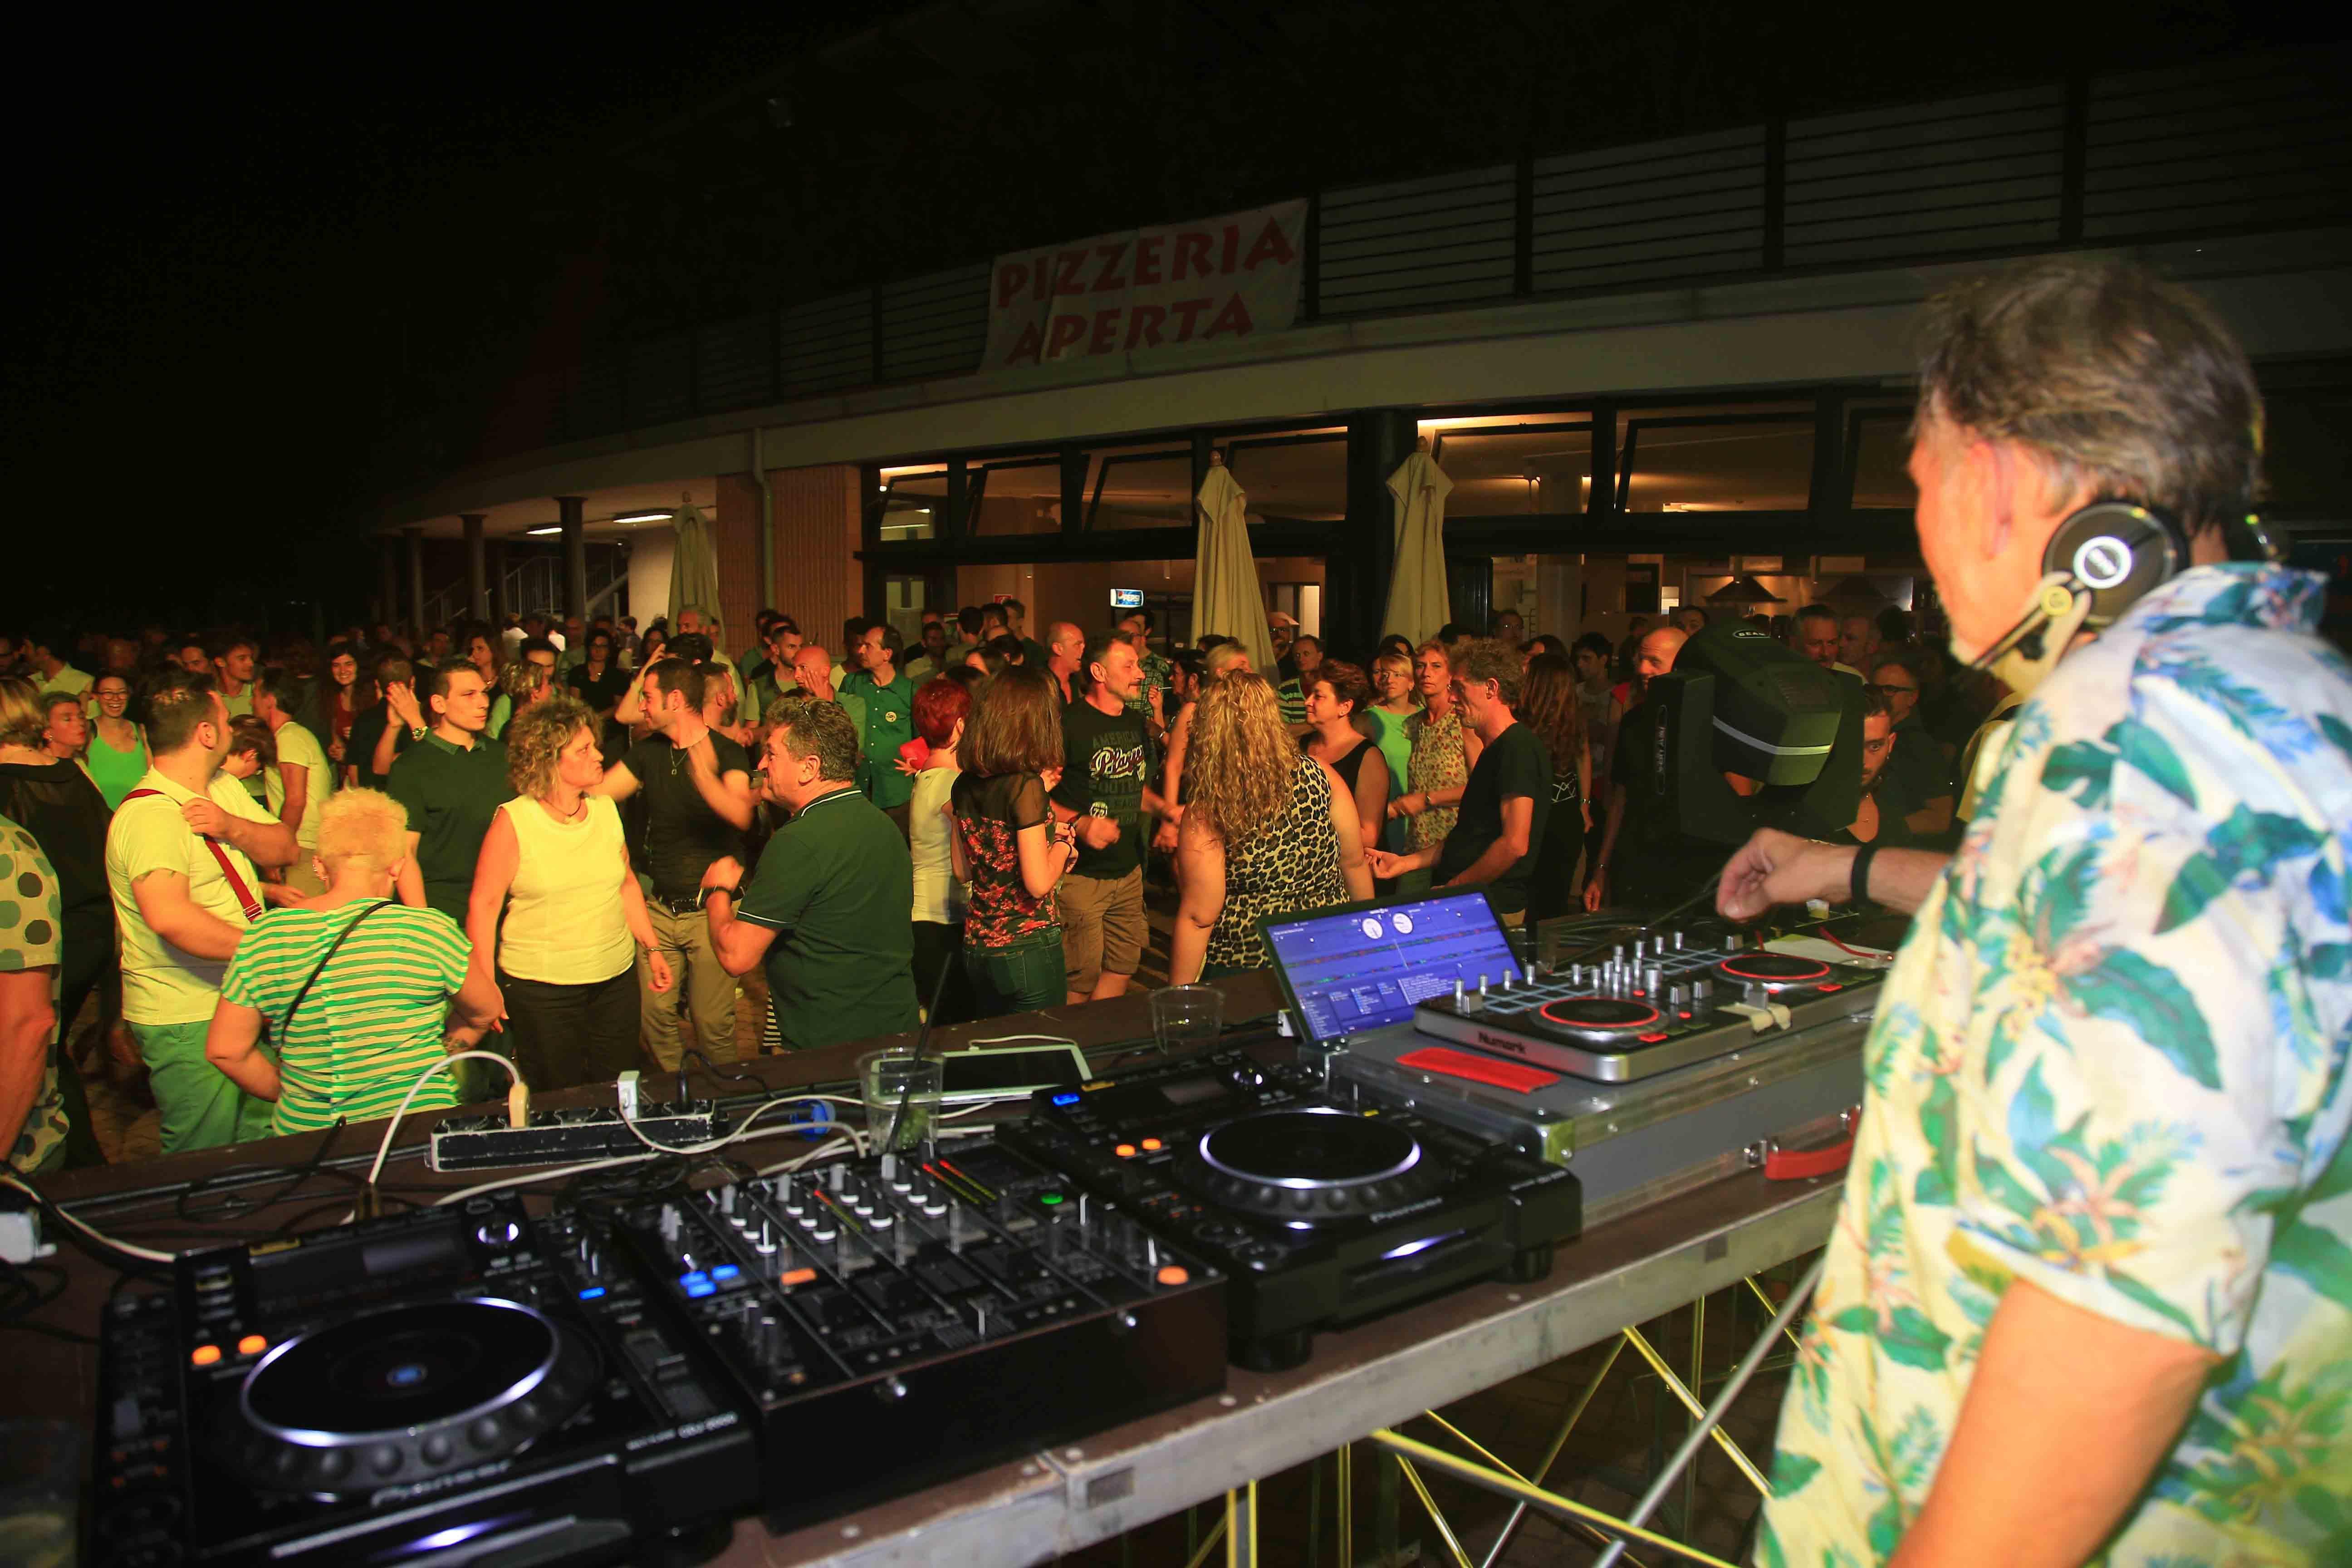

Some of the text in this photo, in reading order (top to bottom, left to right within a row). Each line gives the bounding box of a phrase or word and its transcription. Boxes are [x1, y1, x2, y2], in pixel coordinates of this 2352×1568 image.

[998, 216, 1295, 308] PIZZERIA
[1003, 292, 1254, 365] APERTA
[1479, 1032, 1525, 1053] Numark
